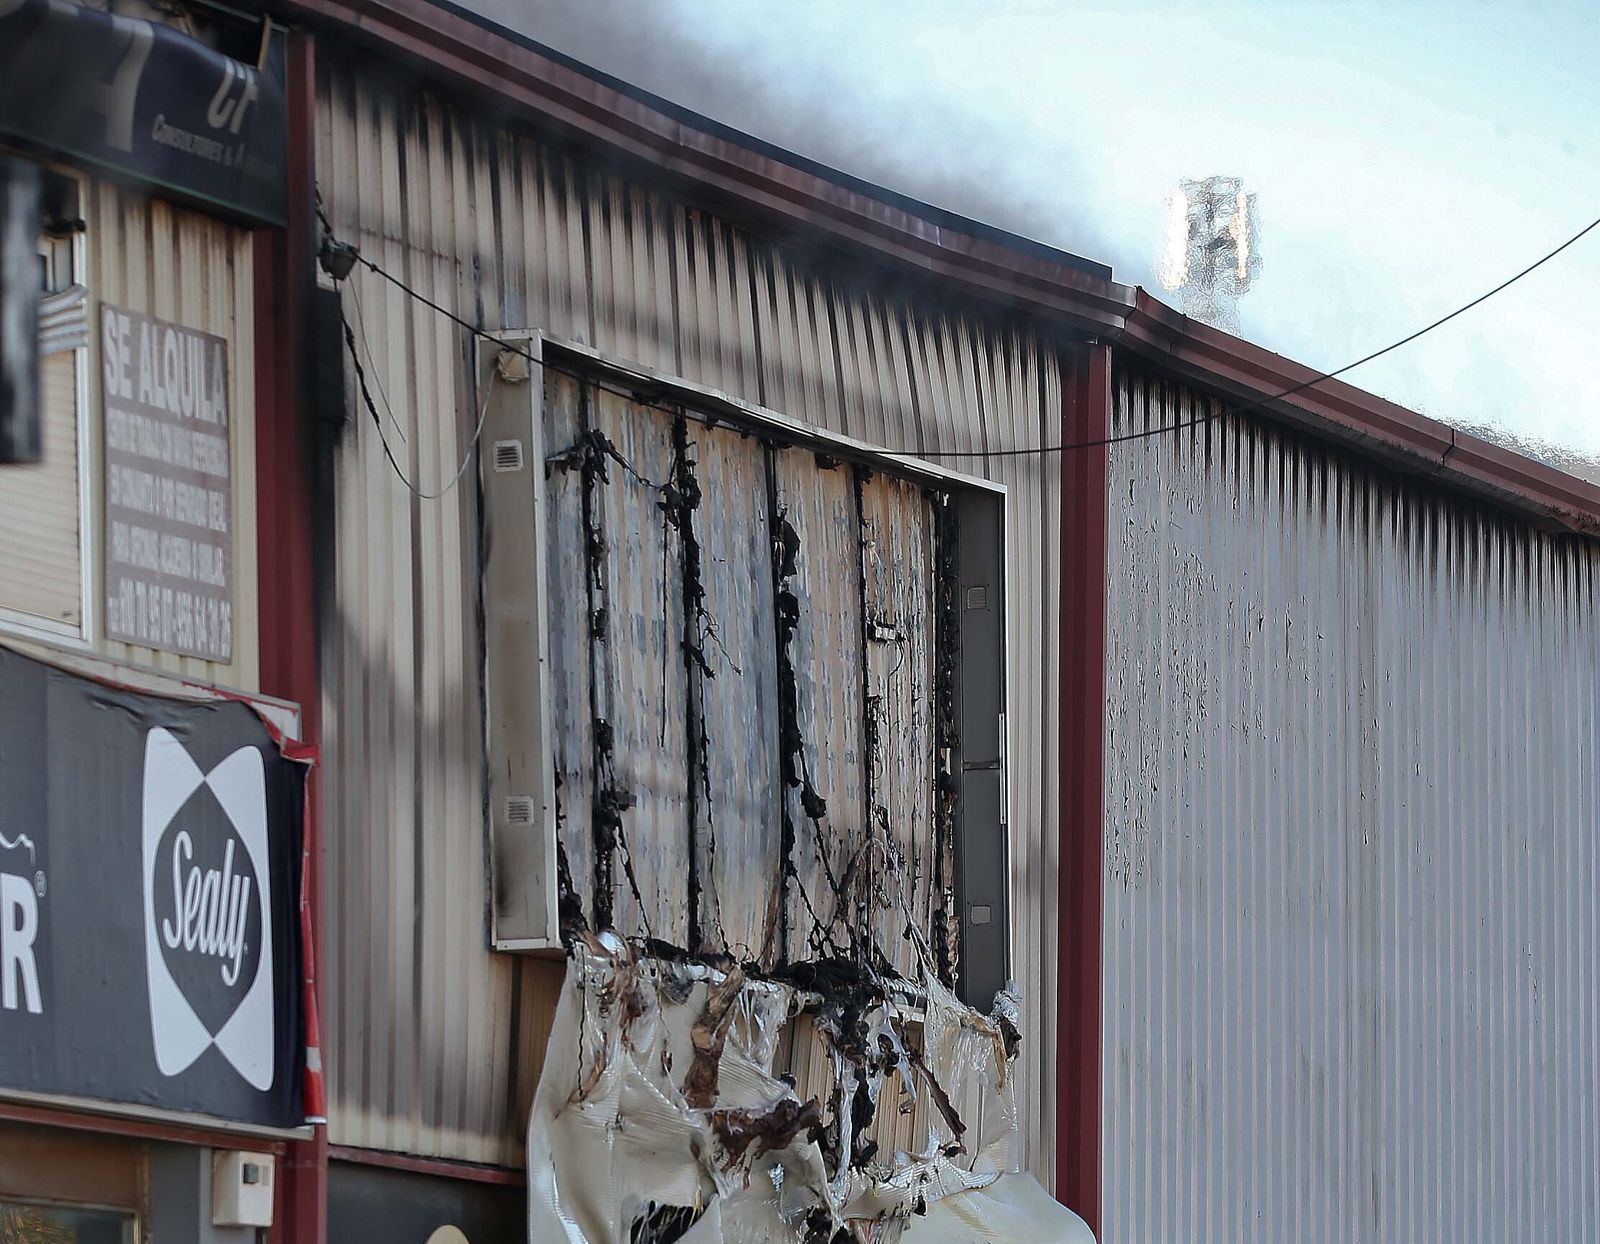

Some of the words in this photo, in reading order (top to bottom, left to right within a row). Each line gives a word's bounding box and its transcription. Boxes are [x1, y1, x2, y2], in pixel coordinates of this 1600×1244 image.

[104, 309, 133, 400] SE
[139, 321, 226, 427] ALQUILA
[163, 831, 250, 986] Sealy
